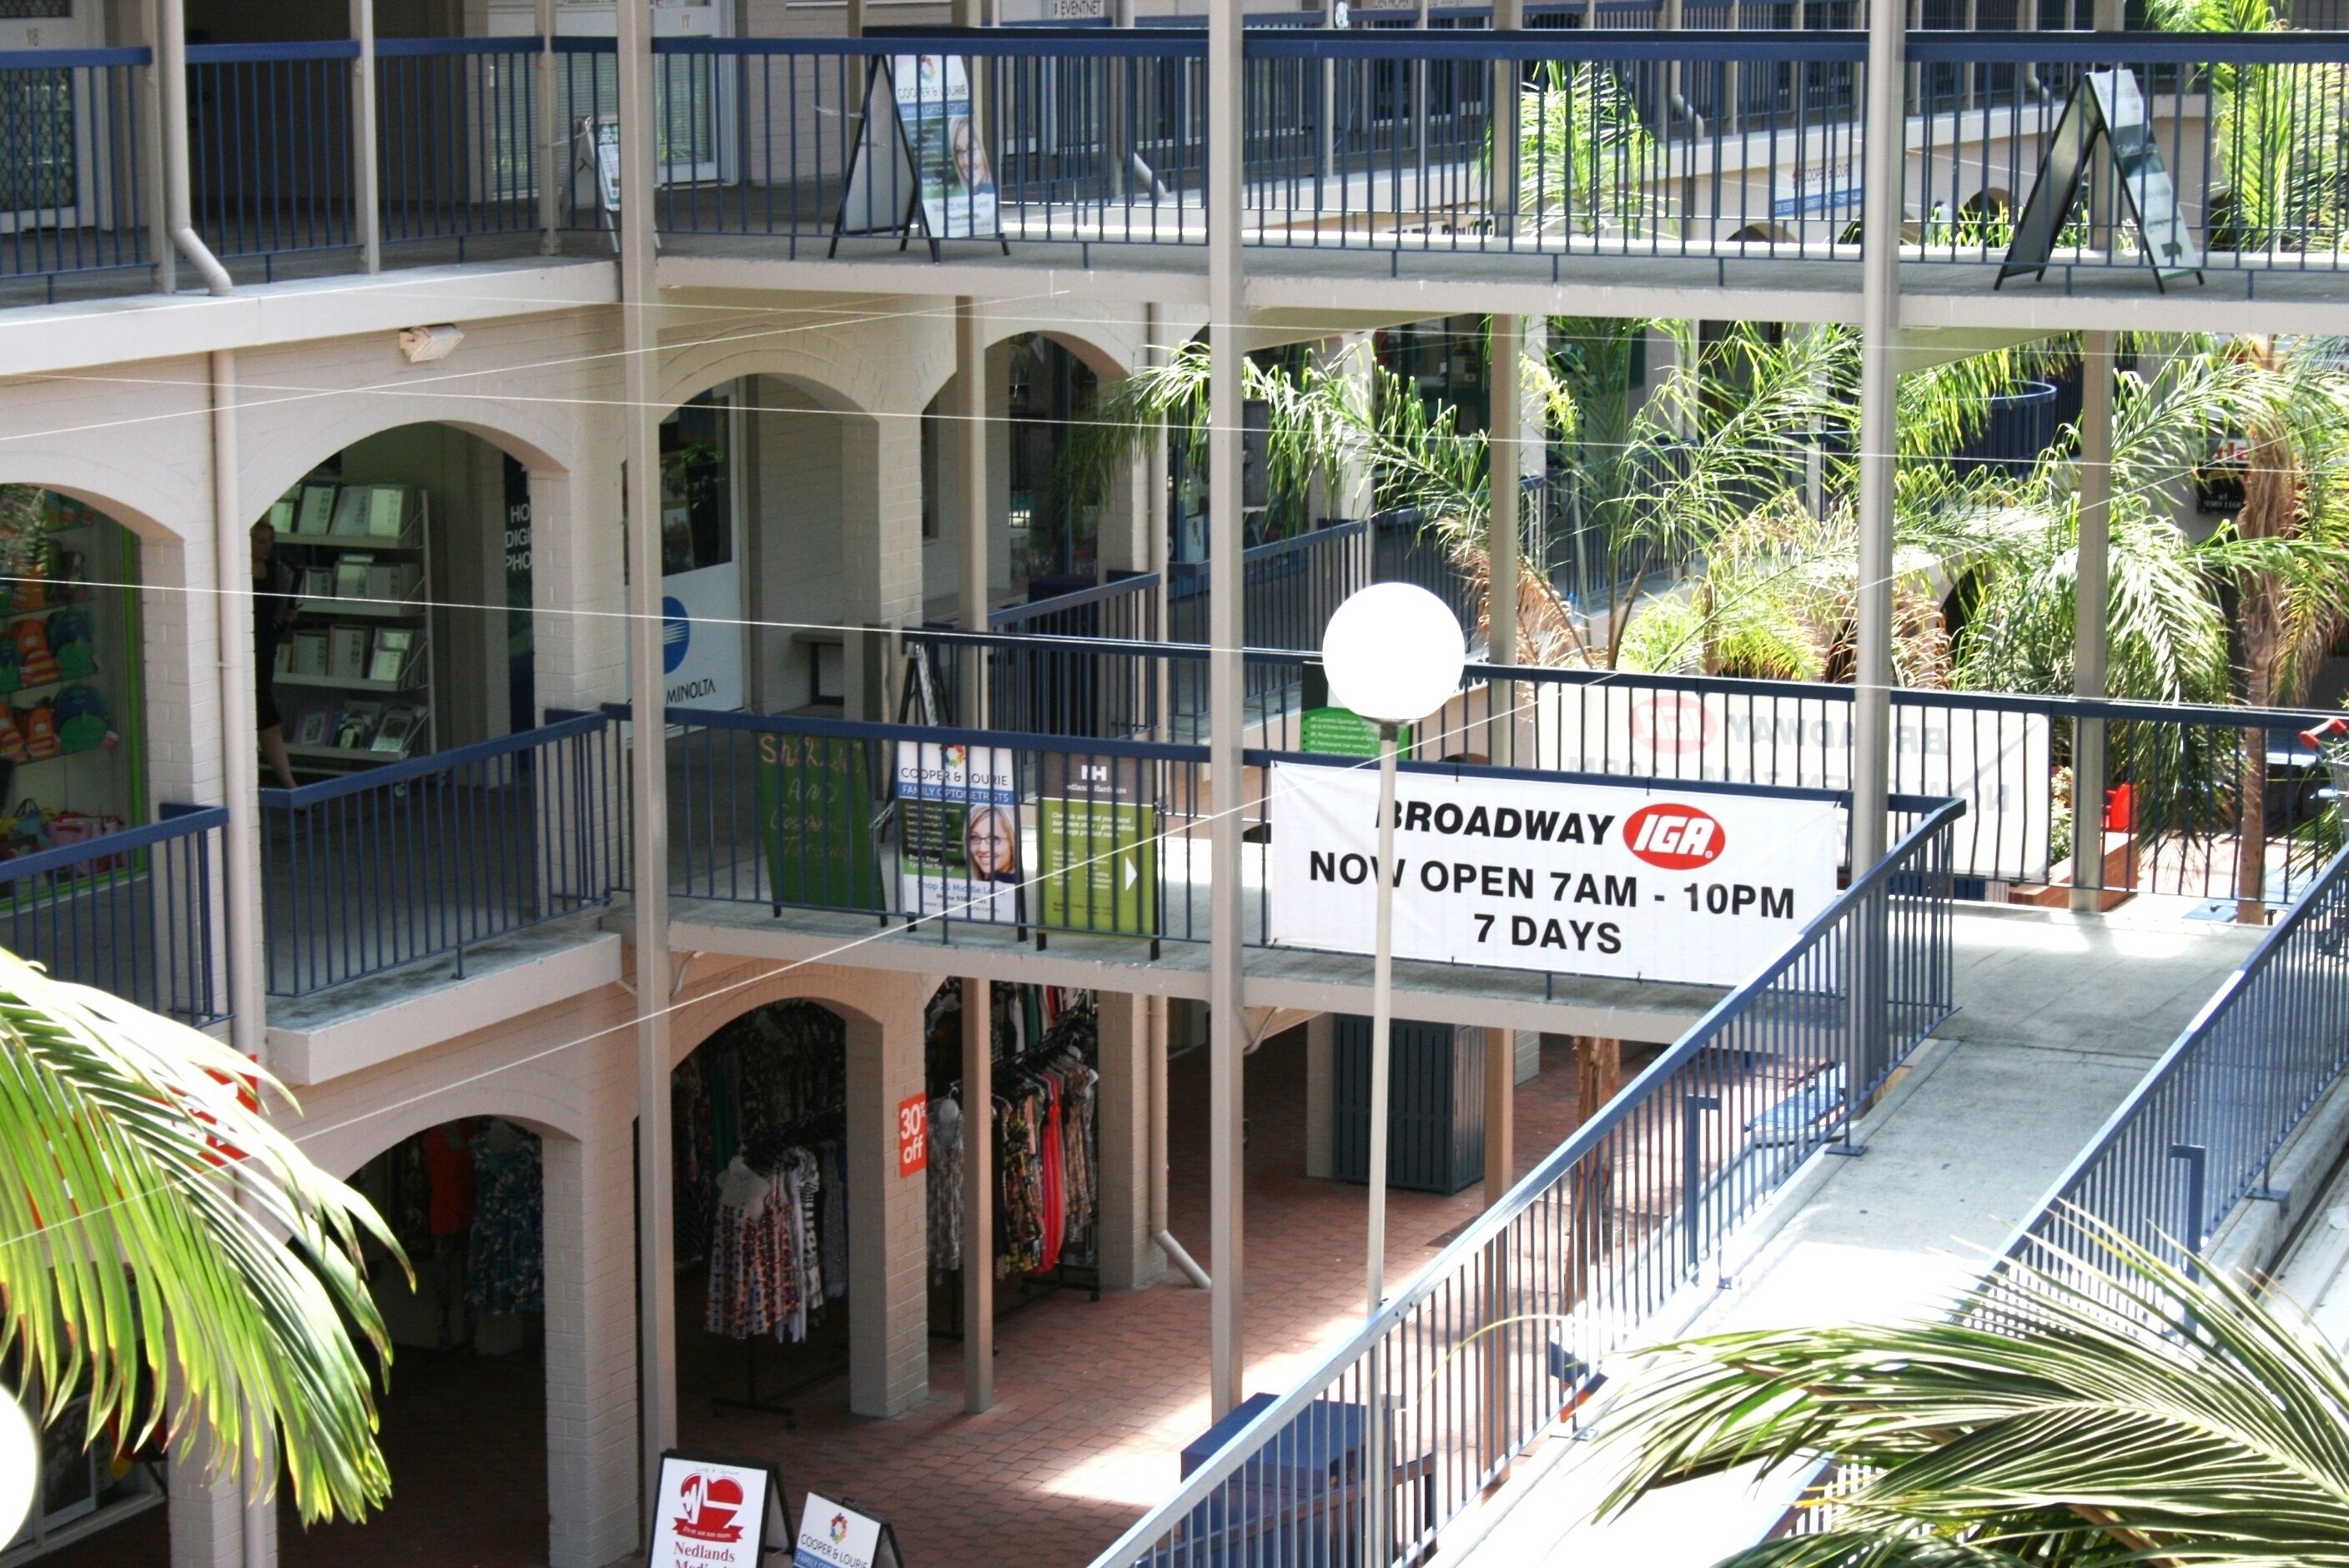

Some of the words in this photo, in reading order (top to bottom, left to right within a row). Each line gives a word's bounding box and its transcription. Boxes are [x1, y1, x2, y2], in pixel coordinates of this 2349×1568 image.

[666, 678, 717, 705] MINOLTA
[901, 766, 951, 782] COOPER
[953, 771, 962, 782] &
[1094, 785, 1128, 794] Hardare
[1632, 813, 1716, 857] IGA
[1310, 851, 1406, 887] NOW
[1421, 860, 1534, 899] OPEN
[1550, 872, 1637, 907] 7AM
[1683, 882, 1794, 919] 10PM
[1474, 914, 1496, 943] 7
[1512, 916, 1622, 953] DAYS
[903, 1134, 923, 1163] off
[674, 1541, 736, 1563] Nedlands
[801, 1534, 832, 1556] COOPER
[832, 1549, 838, 1560] &
